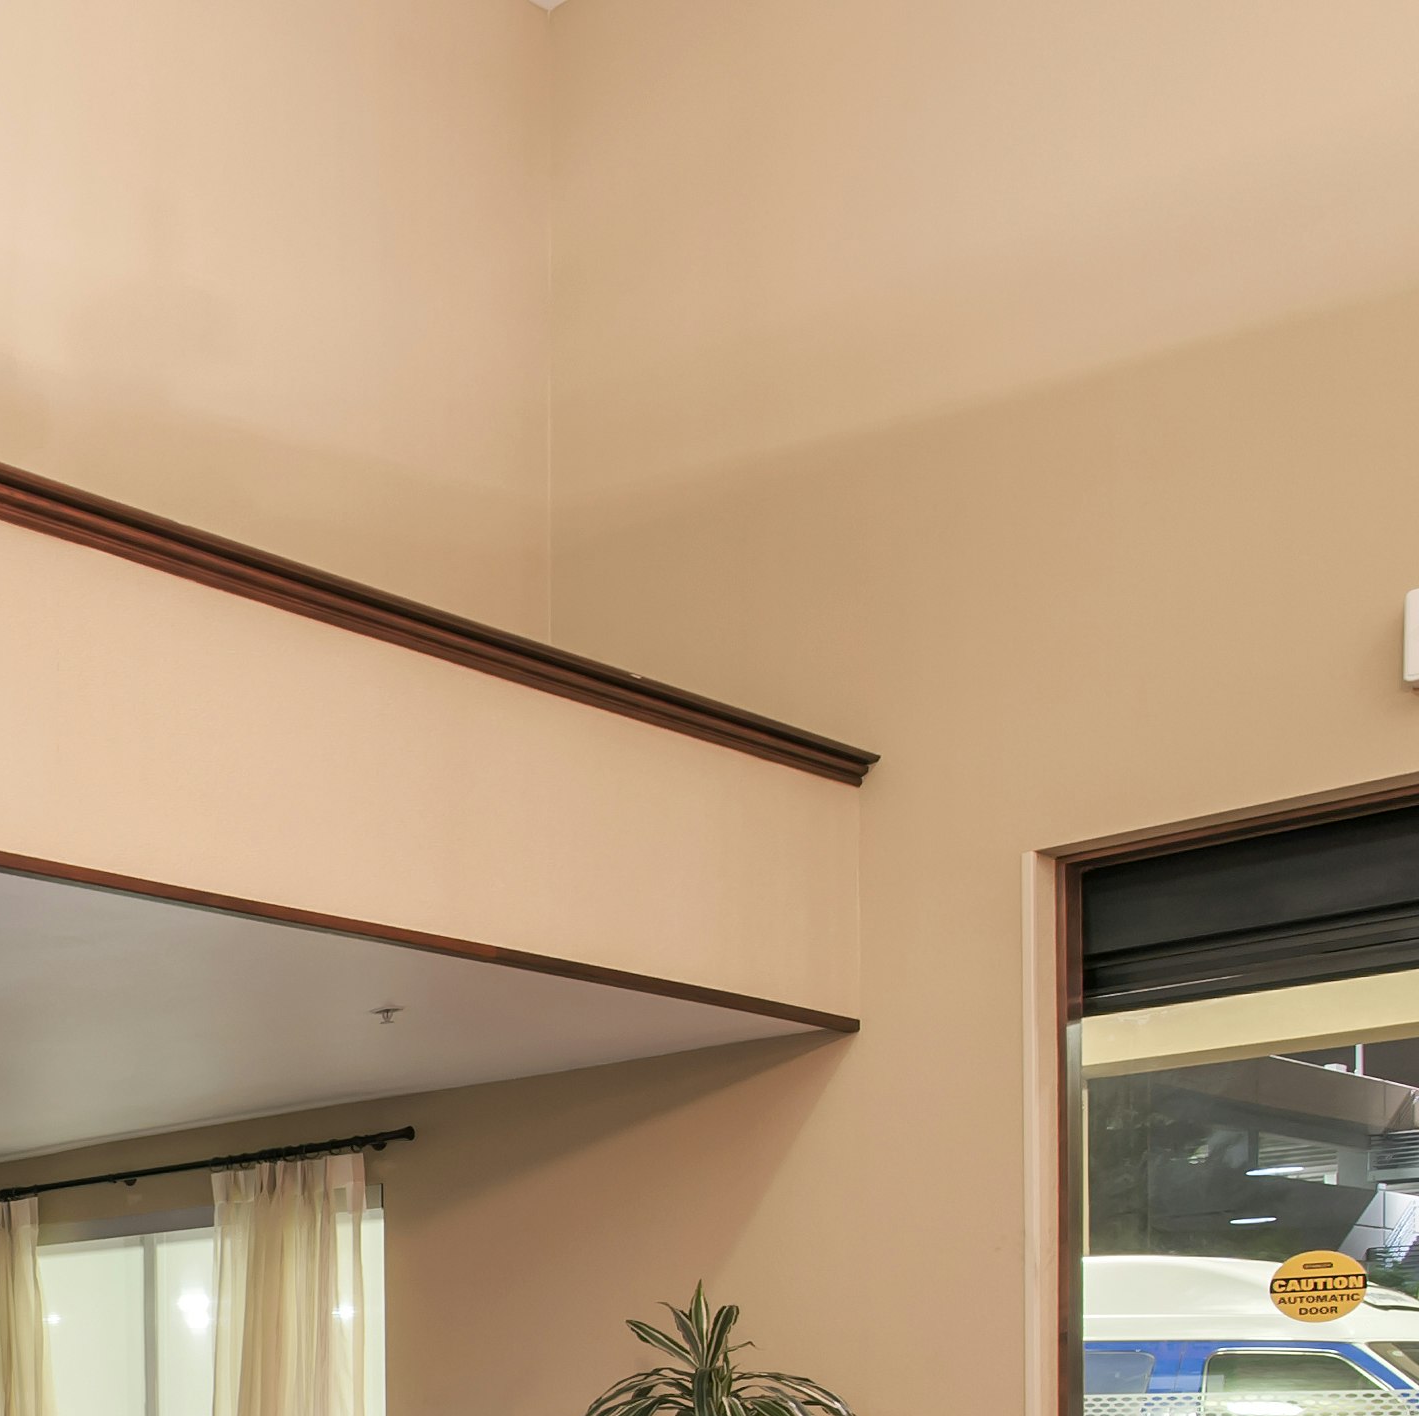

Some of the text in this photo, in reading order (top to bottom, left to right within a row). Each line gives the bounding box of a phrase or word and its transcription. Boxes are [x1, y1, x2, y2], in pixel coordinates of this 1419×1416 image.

[1272, 1275, 1364, 1293] CAUTION
[1277, 1293, 1361, 1305] AUTOMATIC
[1298, 1306, 1338, 1316] DOOR
